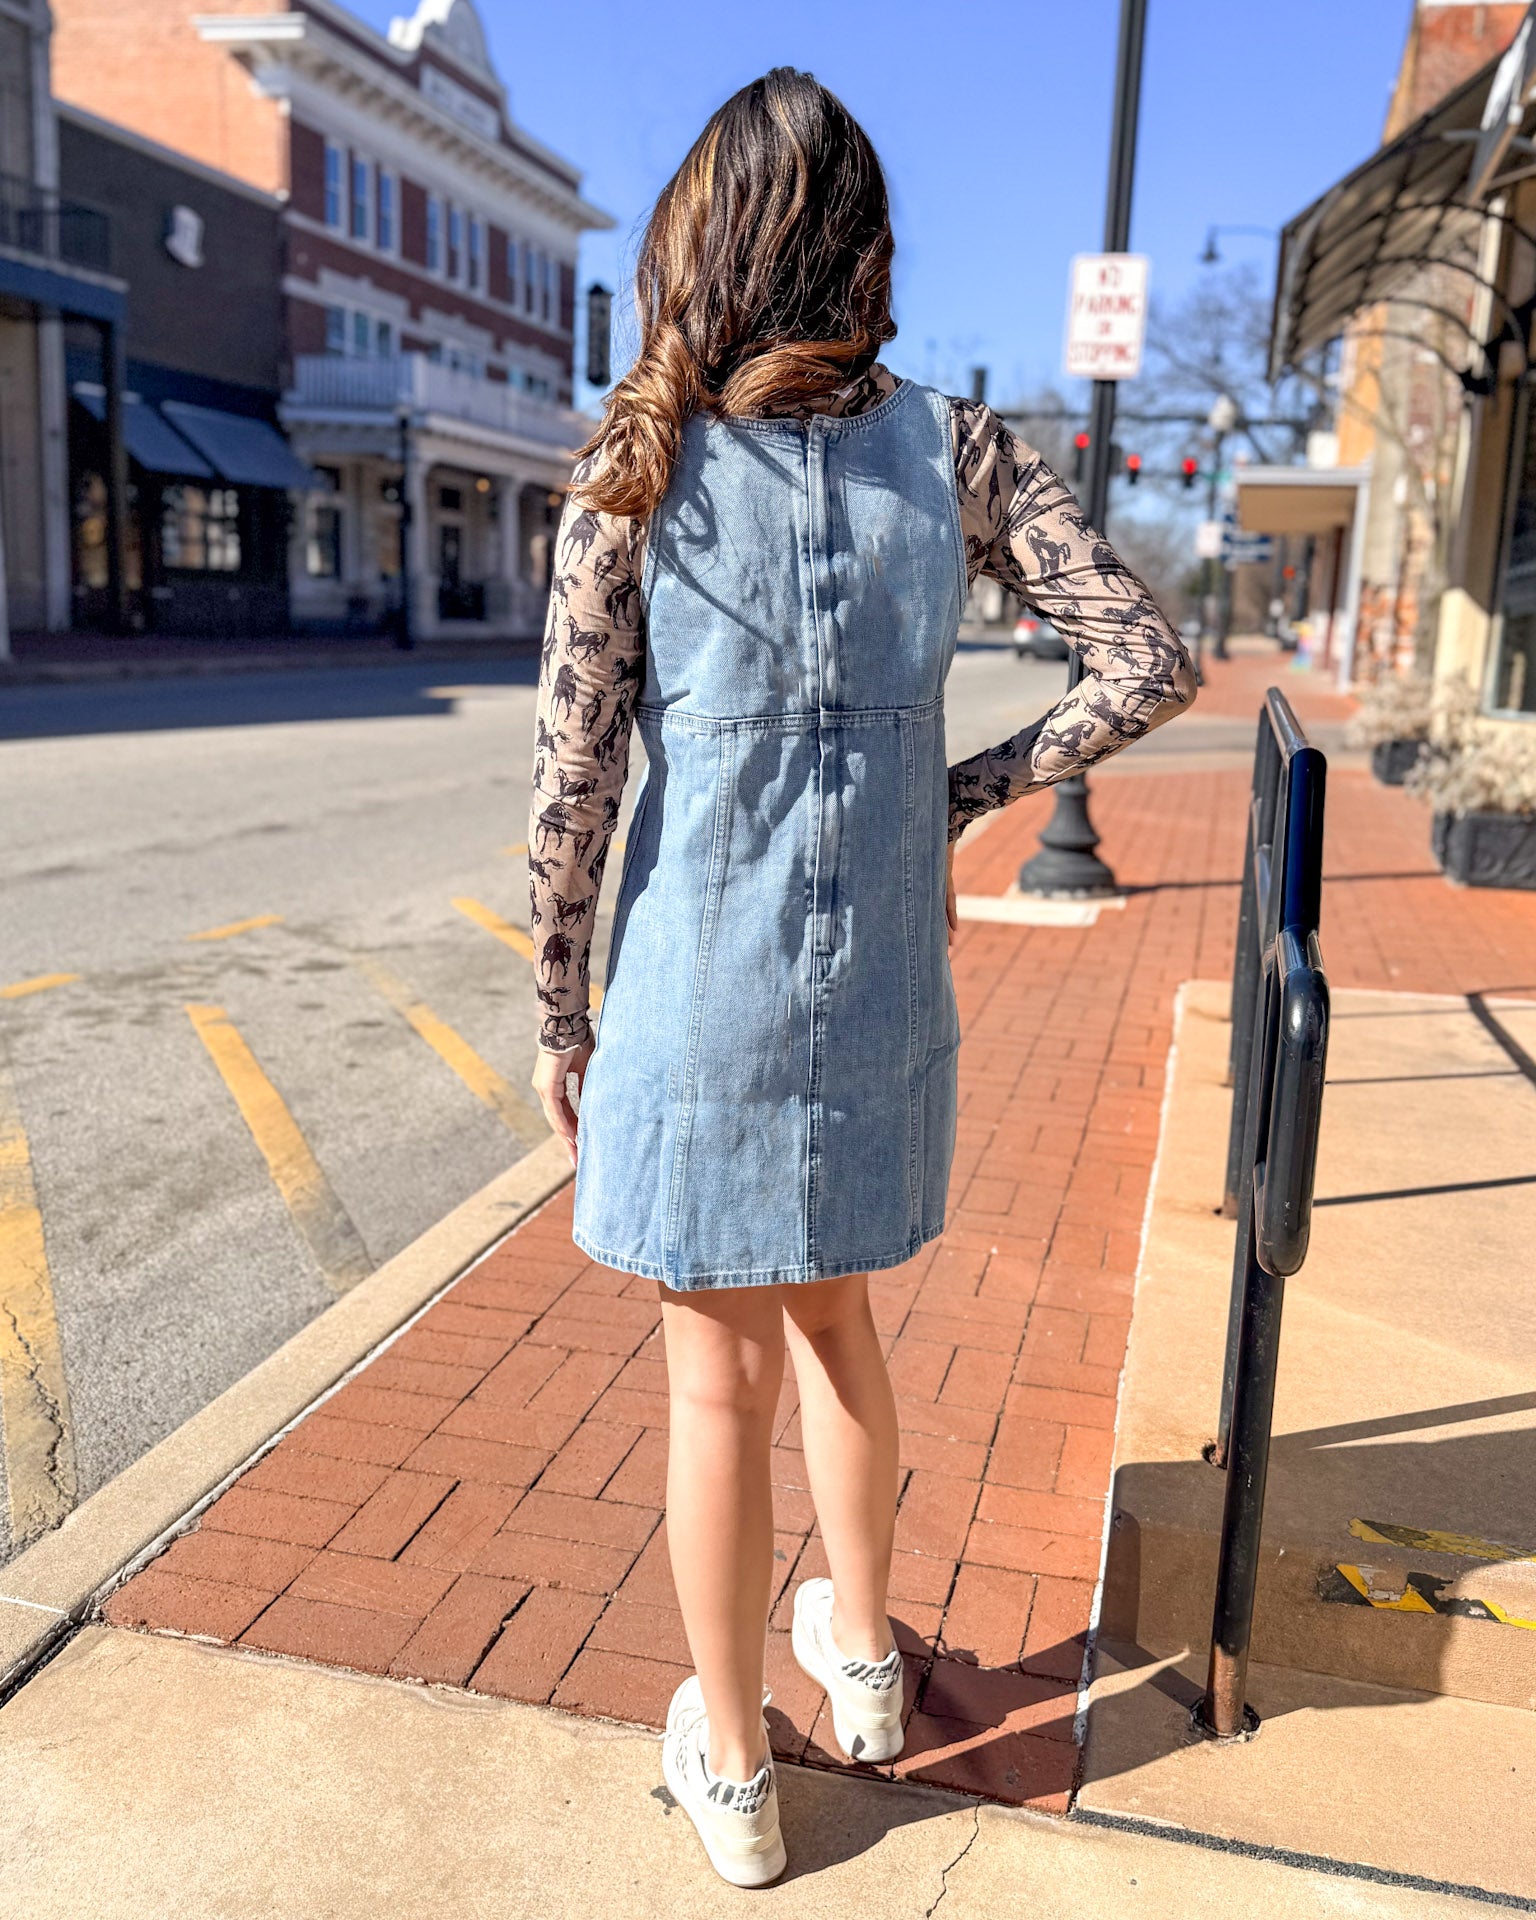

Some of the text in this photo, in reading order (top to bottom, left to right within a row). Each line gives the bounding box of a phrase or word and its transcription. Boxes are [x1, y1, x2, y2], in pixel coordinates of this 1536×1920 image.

[1096, 265, 1121, 288] NO
[1075, 294, 1136, 314] PARKING
[1069, 343, 1137, 362] STOPPING
